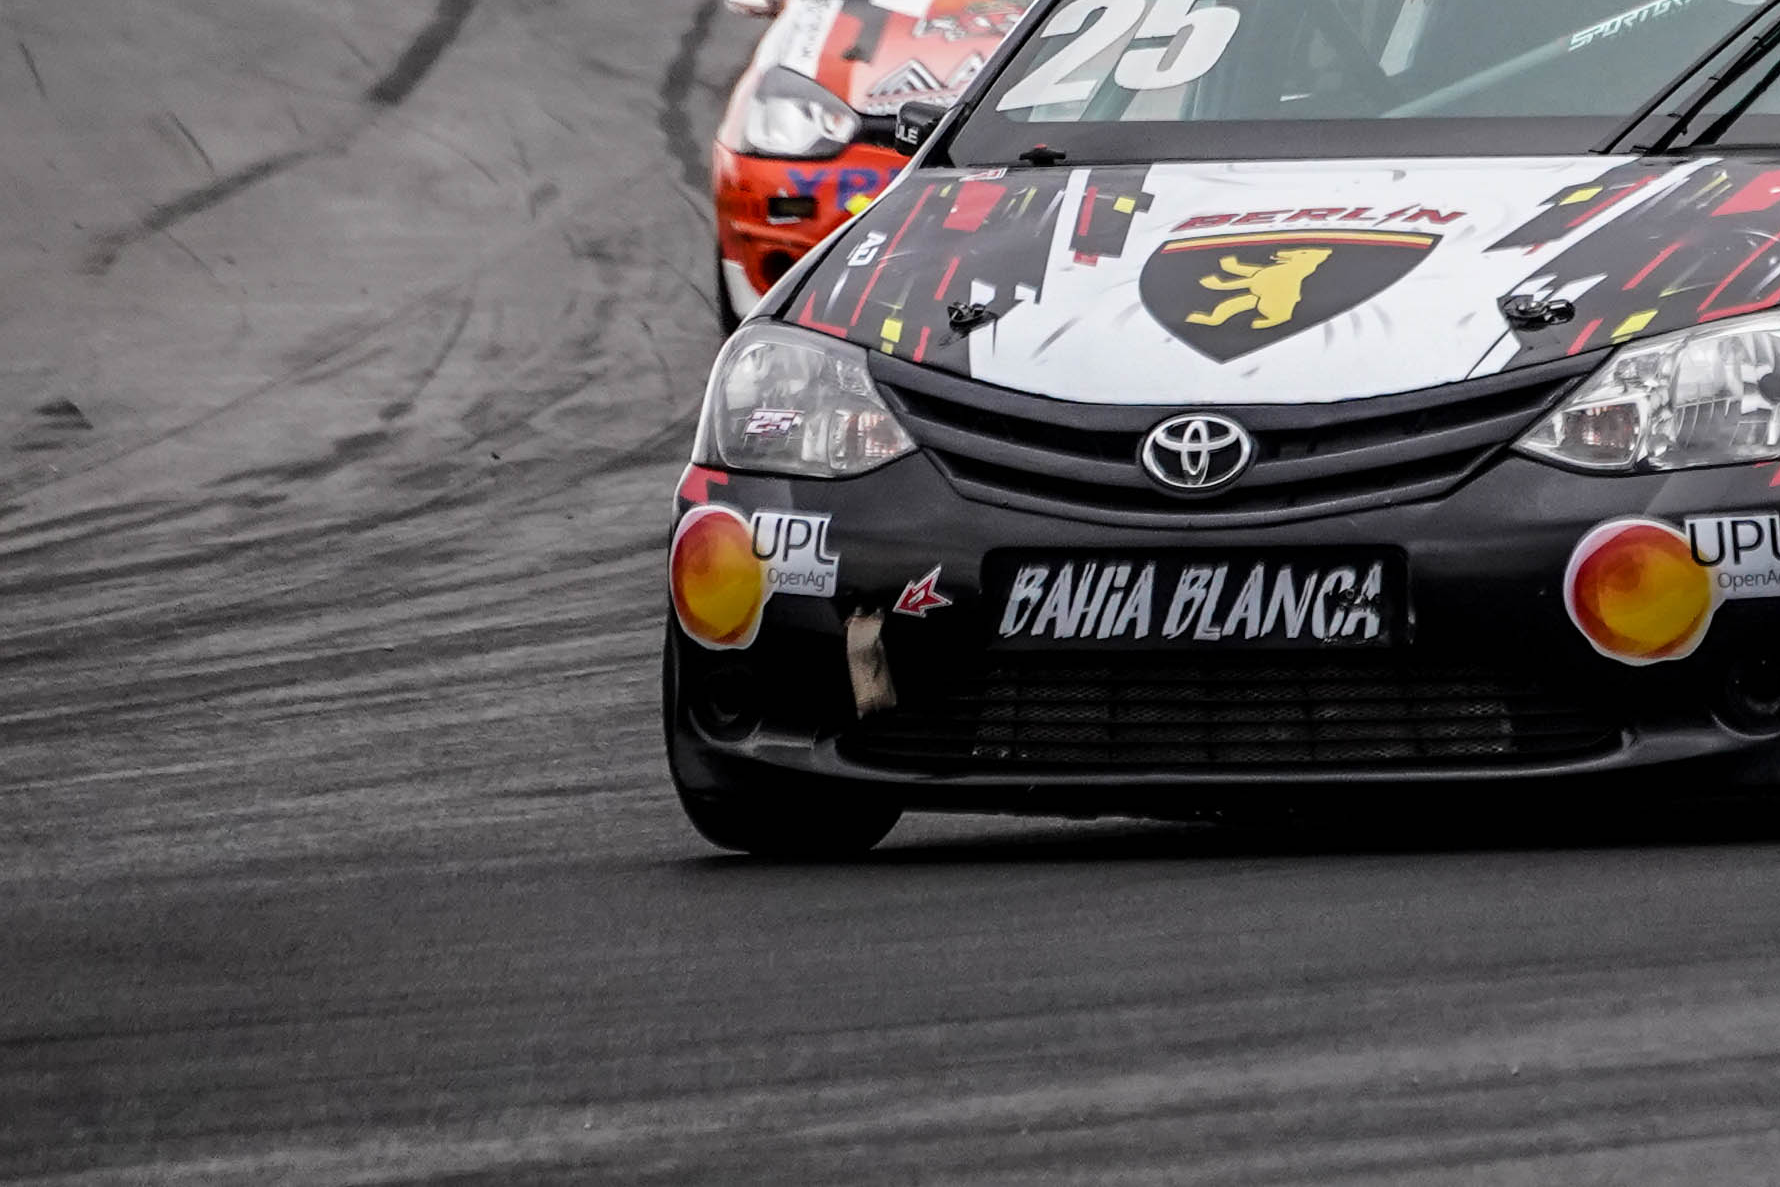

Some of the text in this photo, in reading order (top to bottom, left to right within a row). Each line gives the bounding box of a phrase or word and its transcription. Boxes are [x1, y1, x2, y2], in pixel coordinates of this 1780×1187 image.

[787, 169, 899, 211] YP
[1169, 203, 1469, 233] BERLIN
[751, 514, 835, 565] UPL
[1161, 560, 1384, 643] BLANCA
